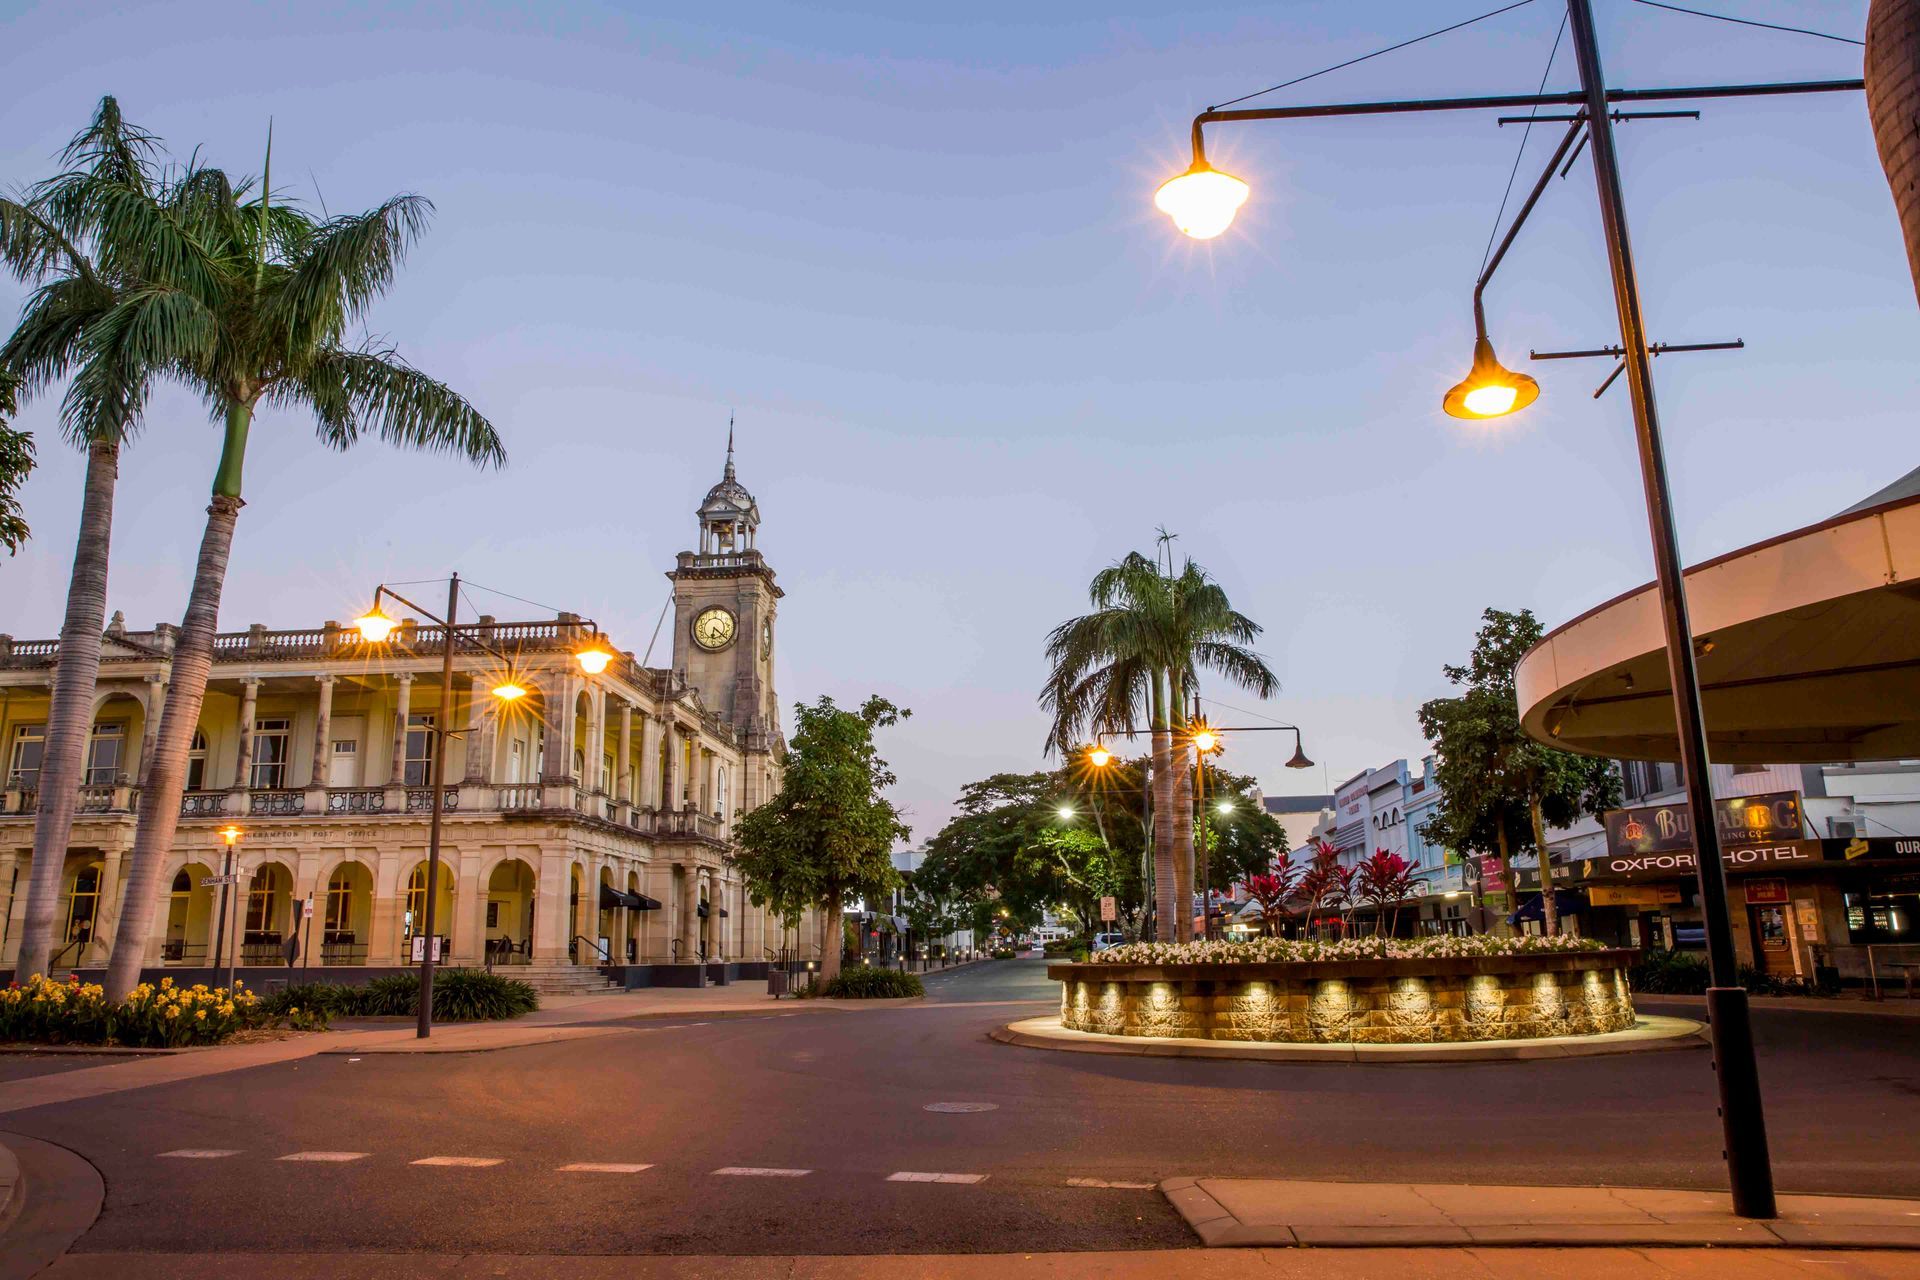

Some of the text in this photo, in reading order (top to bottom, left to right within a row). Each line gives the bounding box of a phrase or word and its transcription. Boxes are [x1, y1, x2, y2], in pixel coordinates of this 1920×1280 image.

[242, 831, 299, 839] OCKHAMPTON
[1895, 841, 1920, 854] OUR
[1610, 854, 1697, 872] OXFOR
